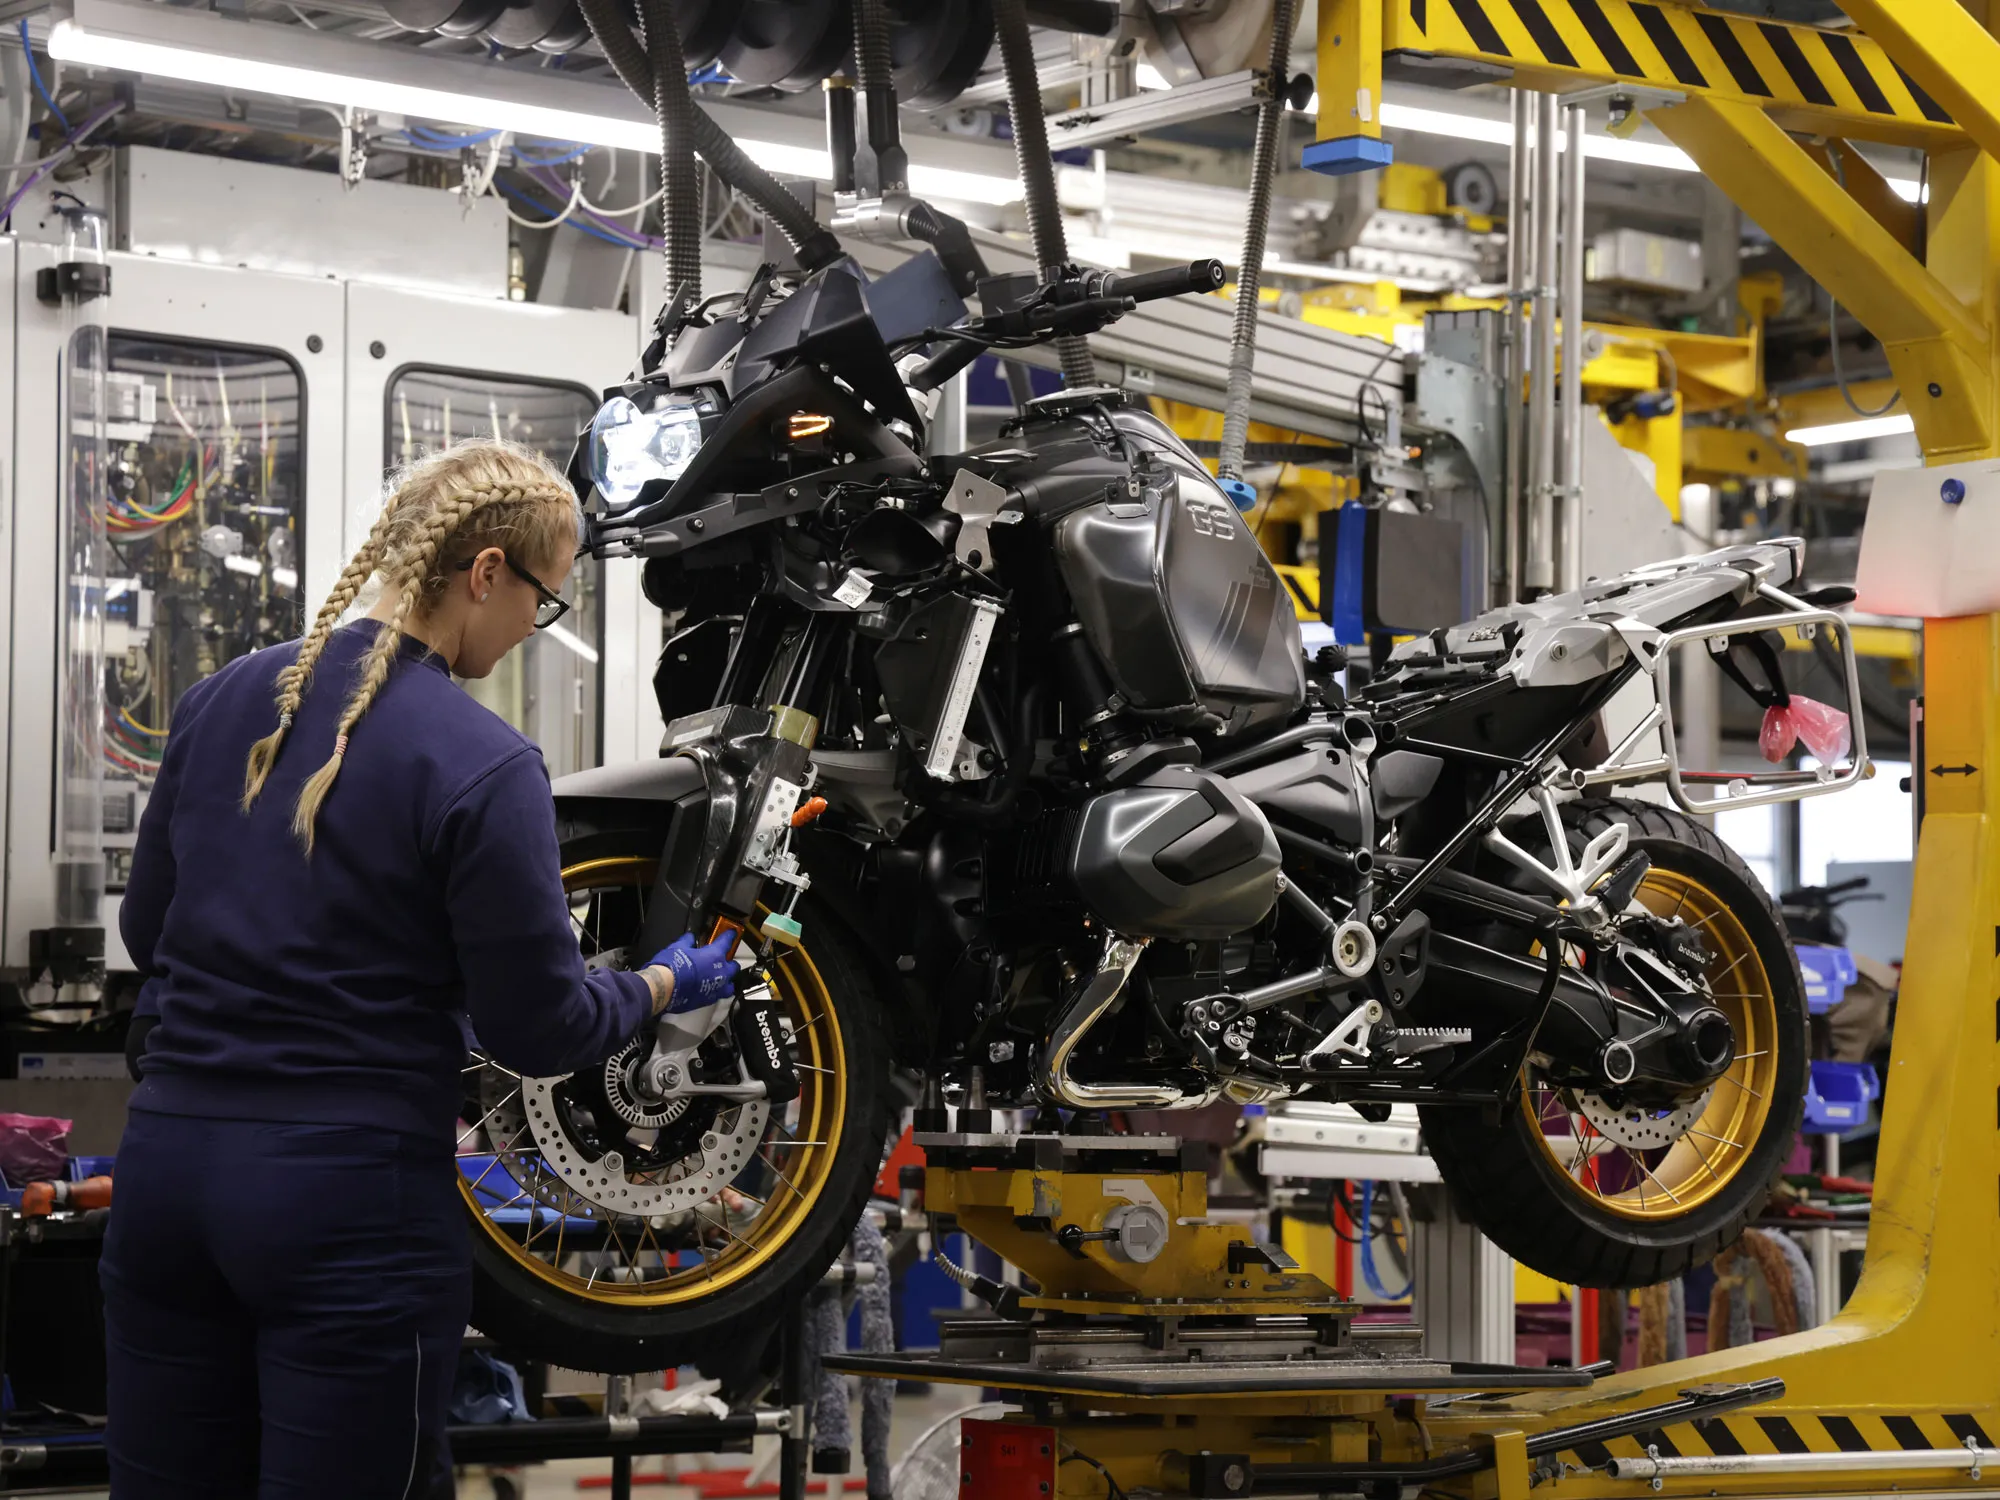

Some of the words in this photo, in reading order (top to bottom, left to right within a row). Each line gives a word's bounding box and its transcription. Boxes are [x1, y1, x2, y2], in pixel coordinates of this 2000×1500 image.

[1185, 499, 1235, 540] GS
[1678, 943, 1705, 964] brembo
[755, 1010, 781, 1069] brembo
